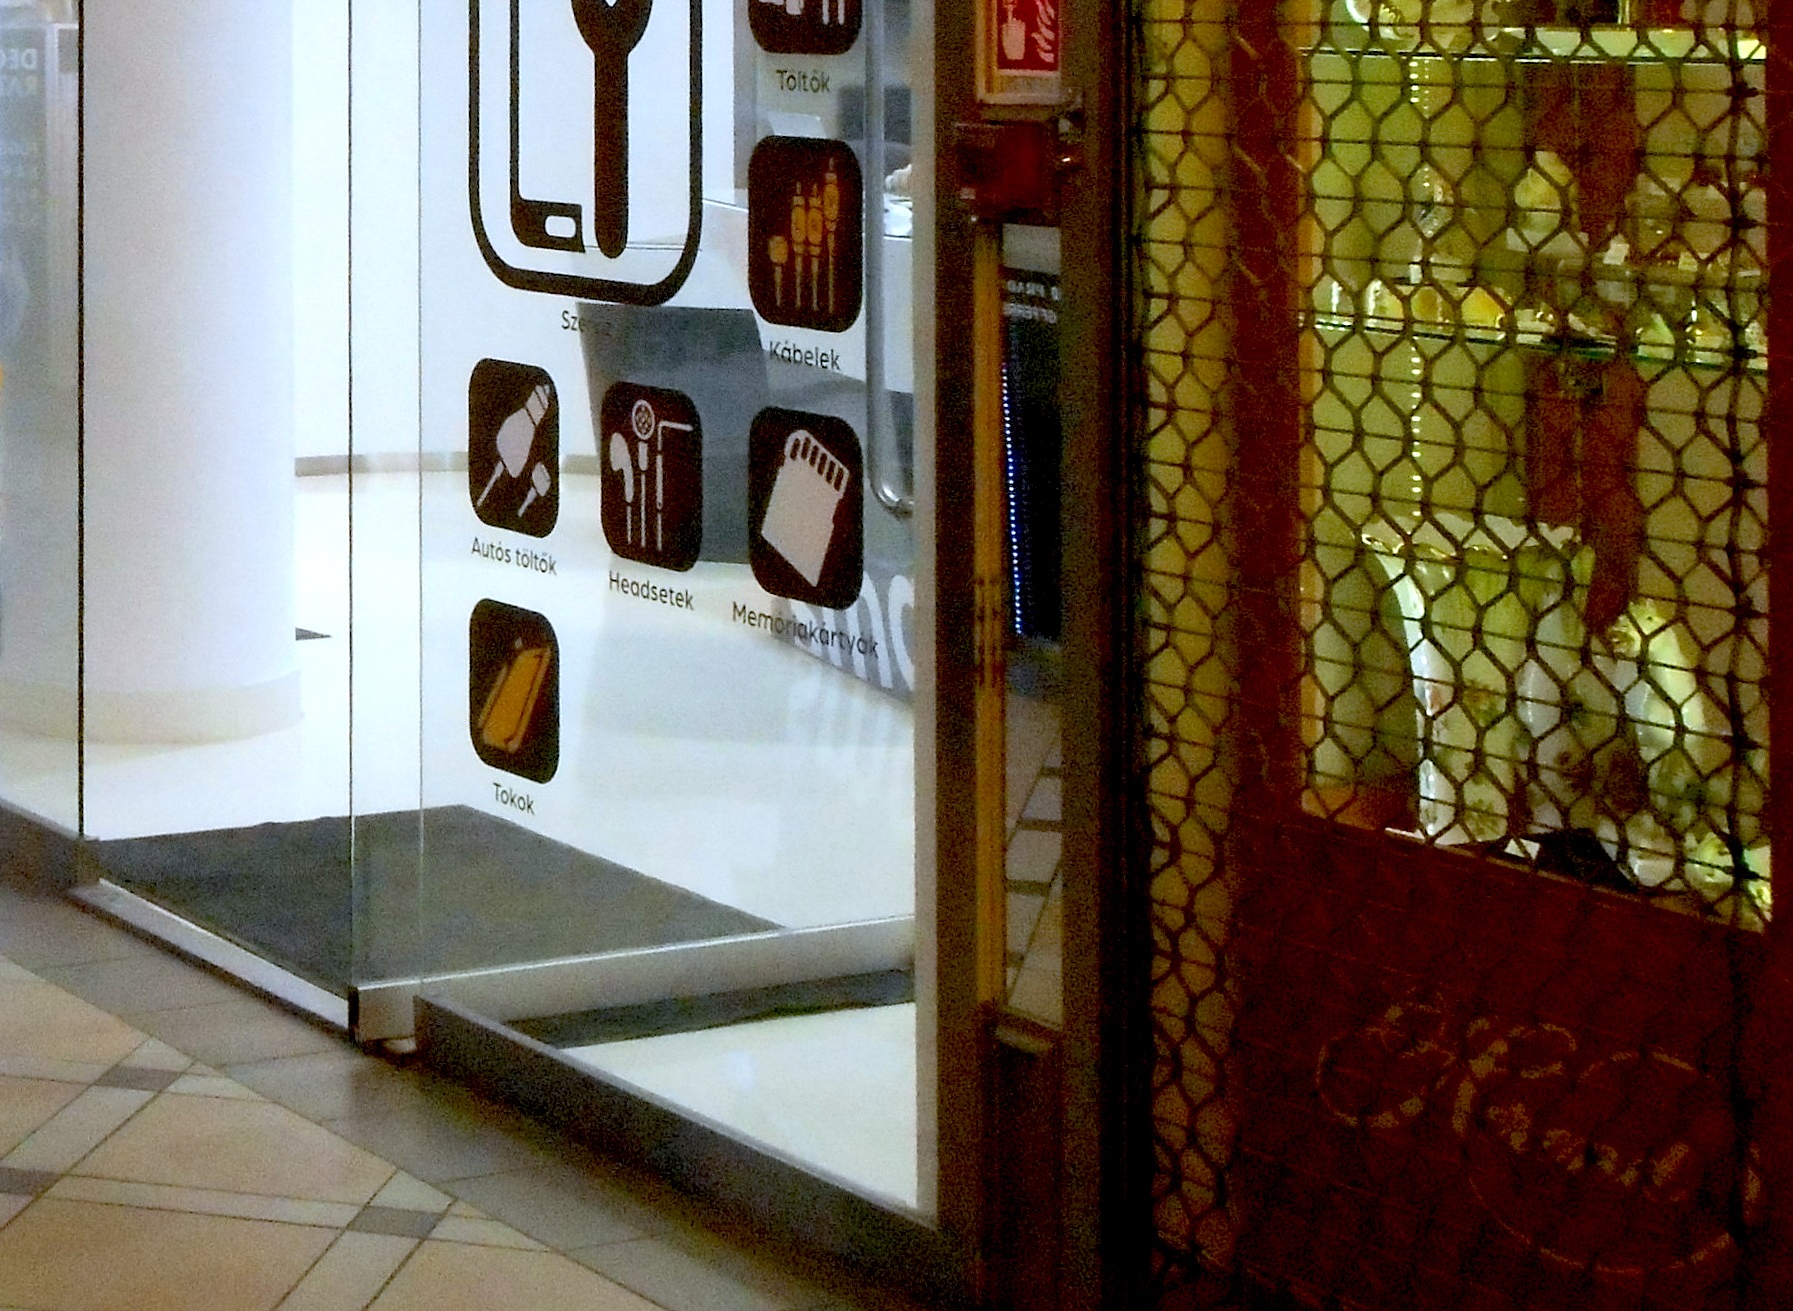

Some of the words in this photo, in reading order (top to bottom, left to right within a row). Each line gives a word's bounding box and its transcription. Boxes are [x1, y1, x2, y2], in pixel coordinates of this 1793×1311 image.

[776, 69, 830, 93] Töltők
[769, 340, 843, 372] Kábelek
[471, 536, 511, 565] Autós
[515, 541, 557, 576] töltők
[609, 569, 695, 611] Headsetek
[732, 599, 879, 660] Memóriakártyák
[492, 782, 536, 816] Tokok
